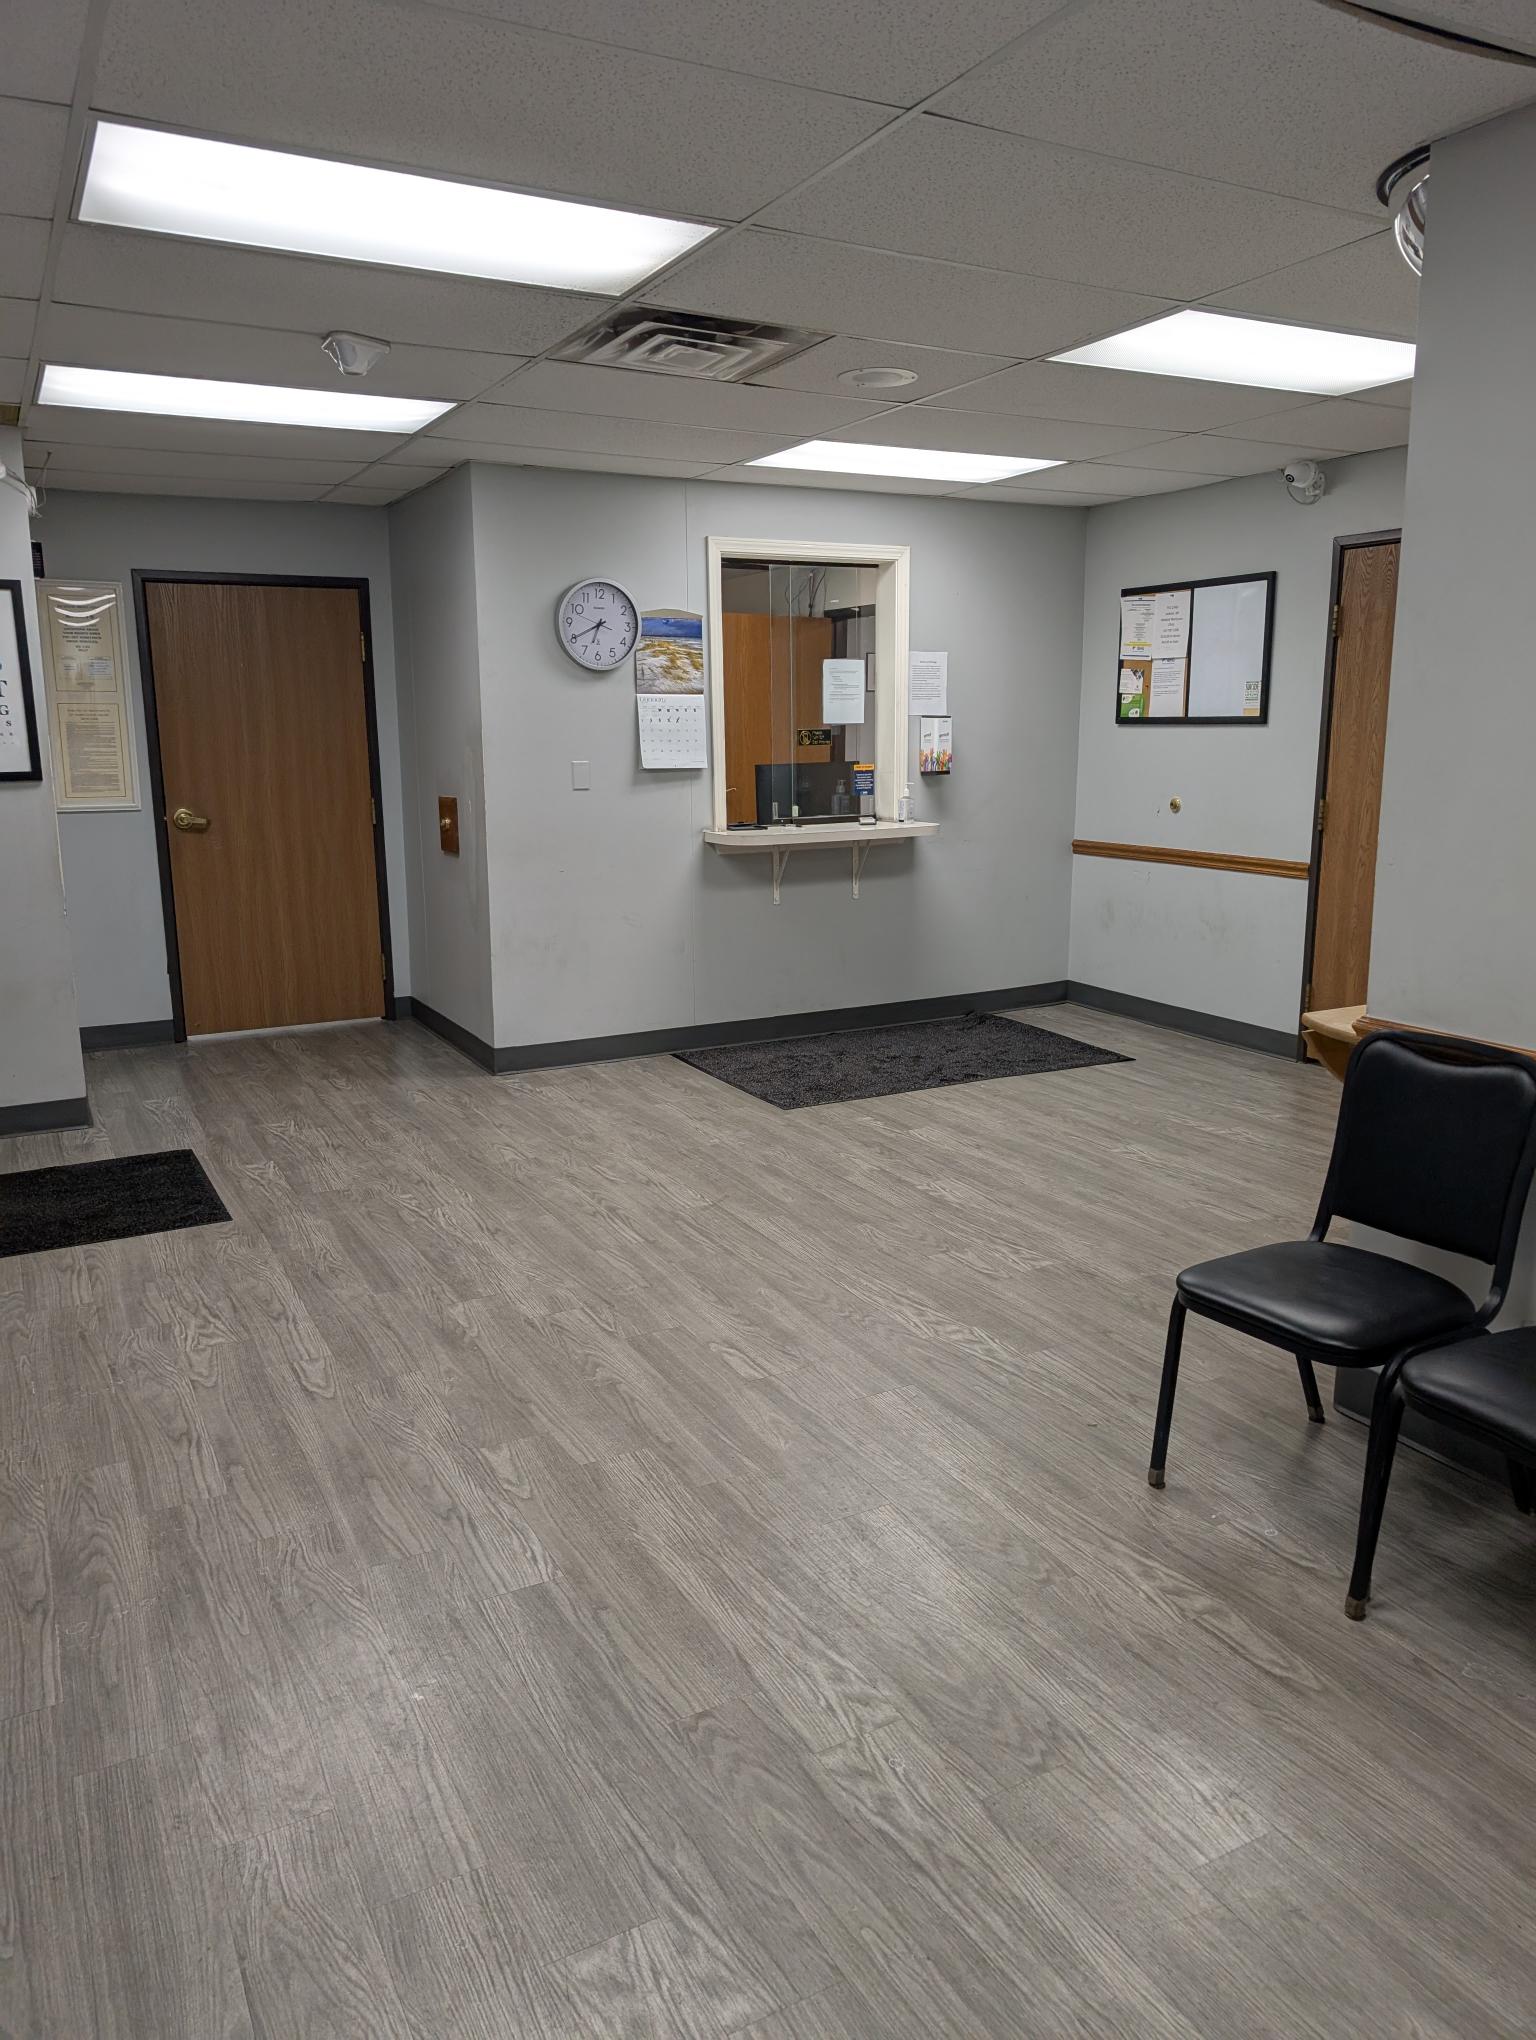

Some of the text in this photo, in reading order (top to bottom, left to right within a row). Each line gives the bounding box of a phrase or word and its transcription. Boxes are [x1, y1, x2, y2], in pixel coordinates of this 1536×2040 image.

[582, 592, 589, 603] 11
[595, 588, 605, 599] 12
[611, 593, 615, 604] 1
[571, 603, 584, 615] 10
[620, 605, 627, 615] 2
[566, 617, 573, 627] 9
[624, 622, 631, 633] 3
[570, 633, 577, 644] 8
[620, 637, 627, 647] 4
[581, 645, 588, 655] 7
[609, 648, 616, 658] 5
[595, 651, 601, 661] 6
[0, 704, 9, 716] G
